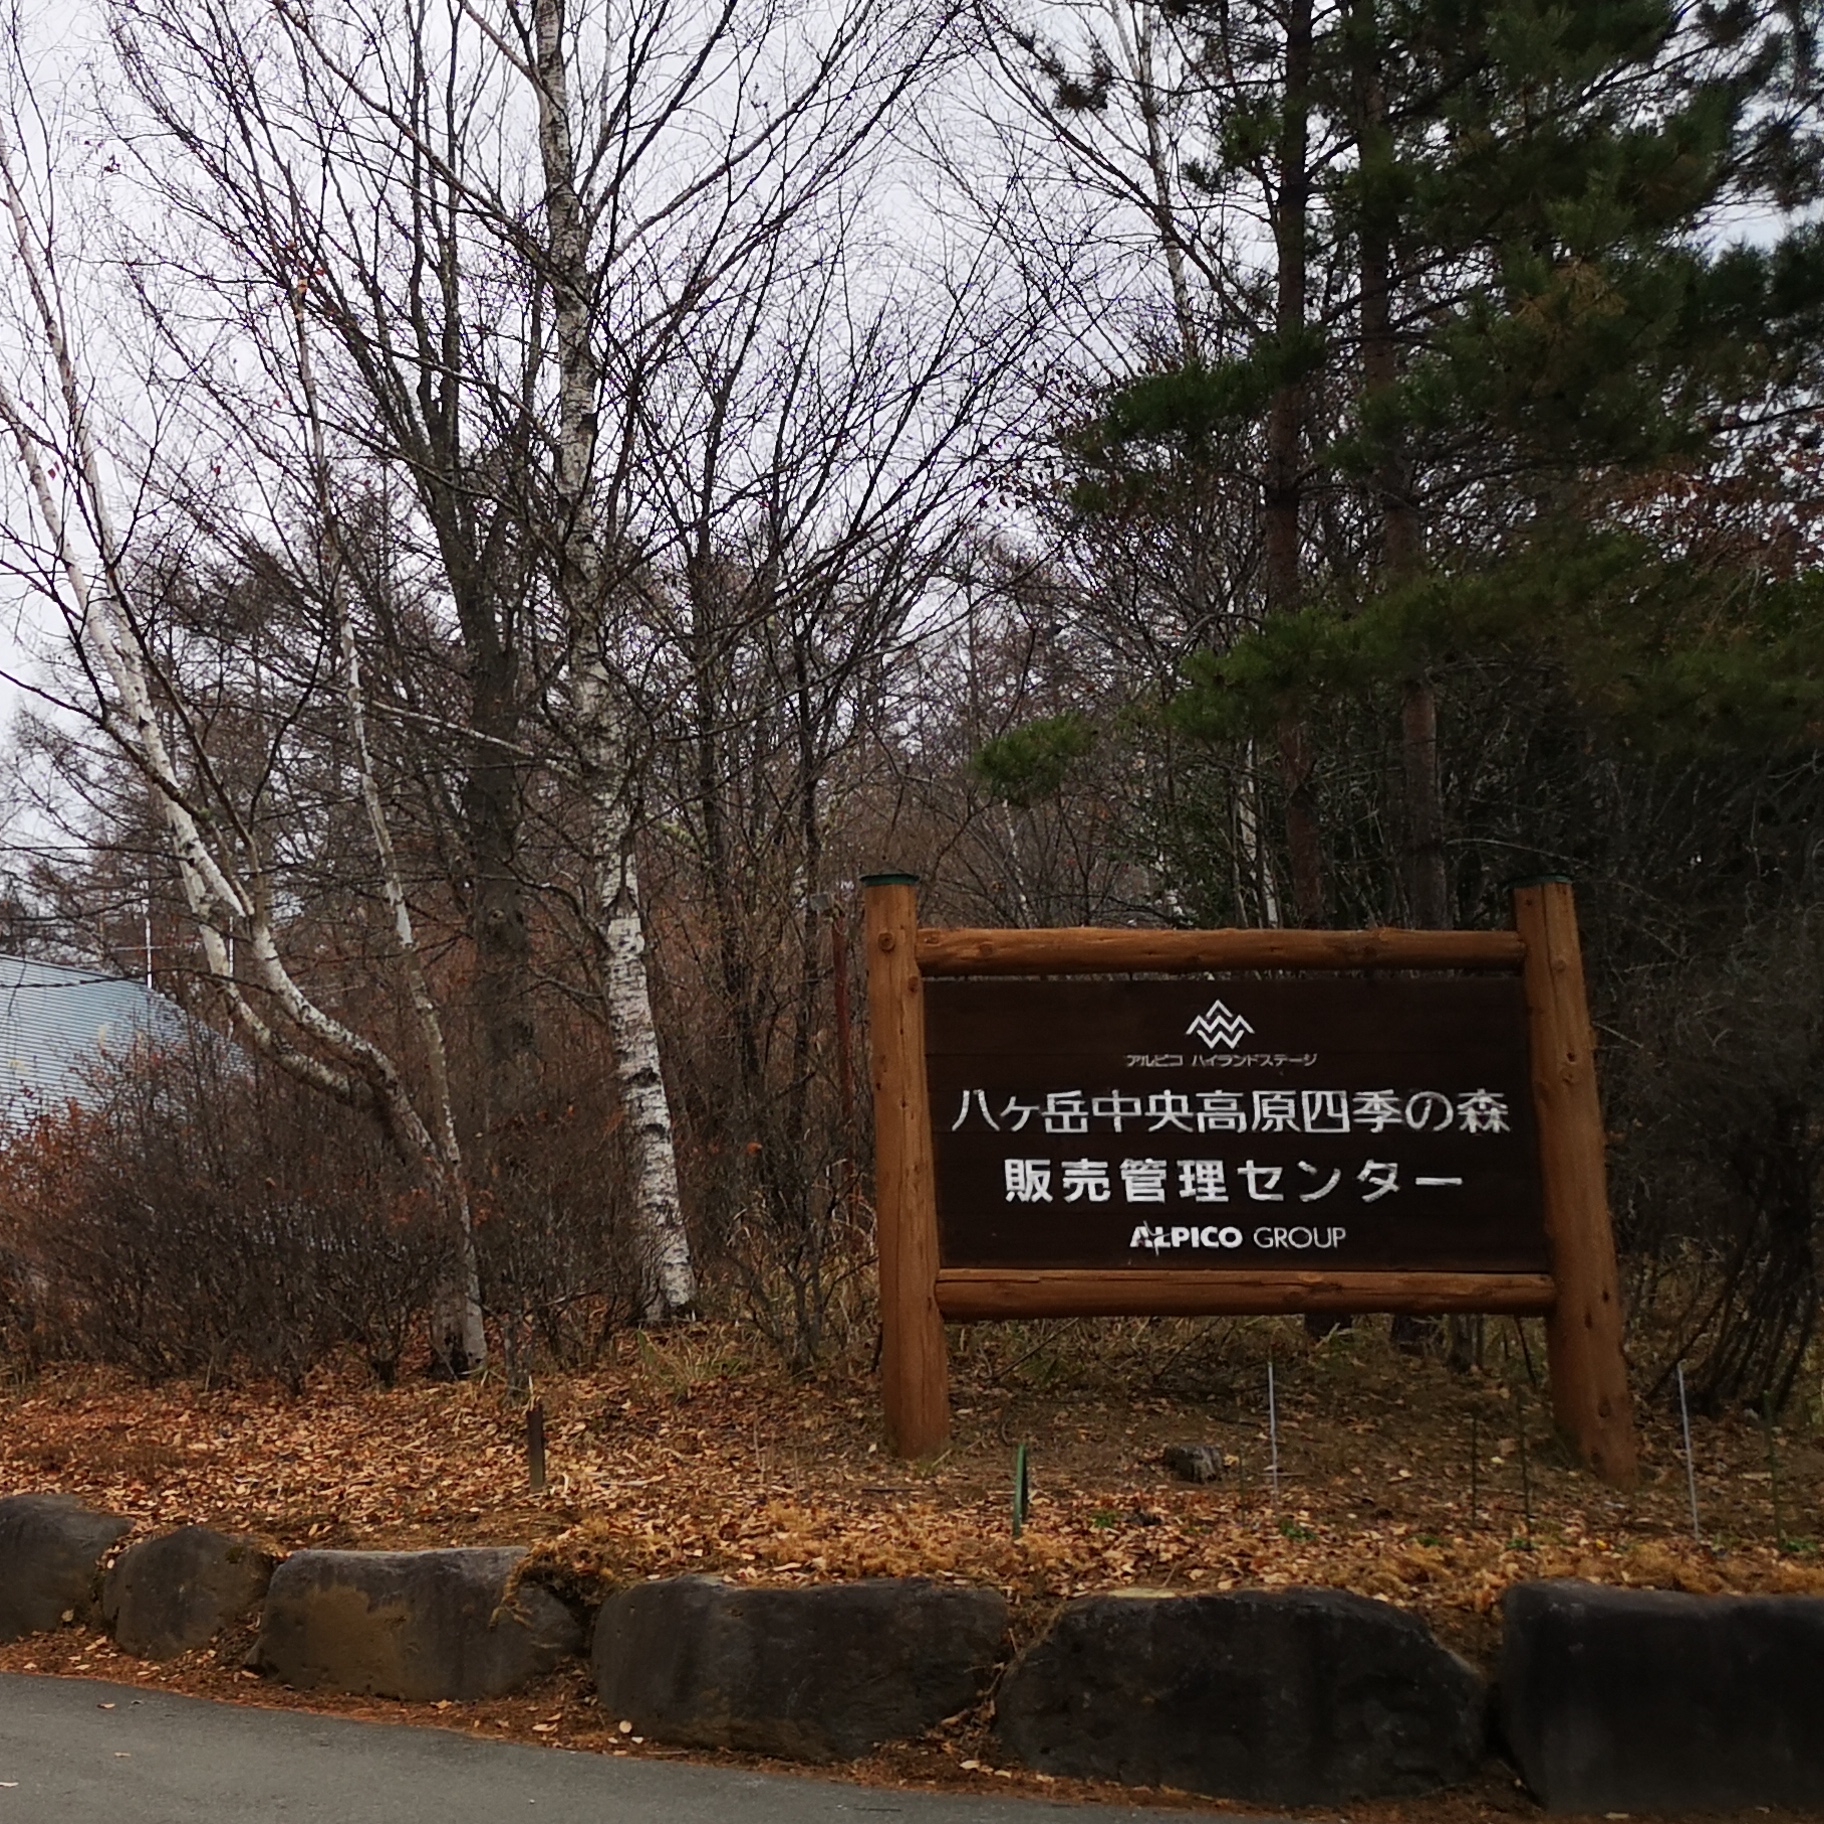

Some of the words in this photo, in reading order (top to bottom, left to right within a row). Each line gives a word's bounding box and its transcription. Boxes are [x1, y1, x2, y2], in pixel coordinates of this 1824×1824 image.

[1126, 1053, 1184, 1068] アルピコ
[1191, 1053, 1318, 1068] ハイランドステージ
[1004, 1157, 1464, 1203] 販売管理センター
[1129, 1221, 1243, 1256] ALPICO
[1253, 1226, 1346, 1249] GROUP
